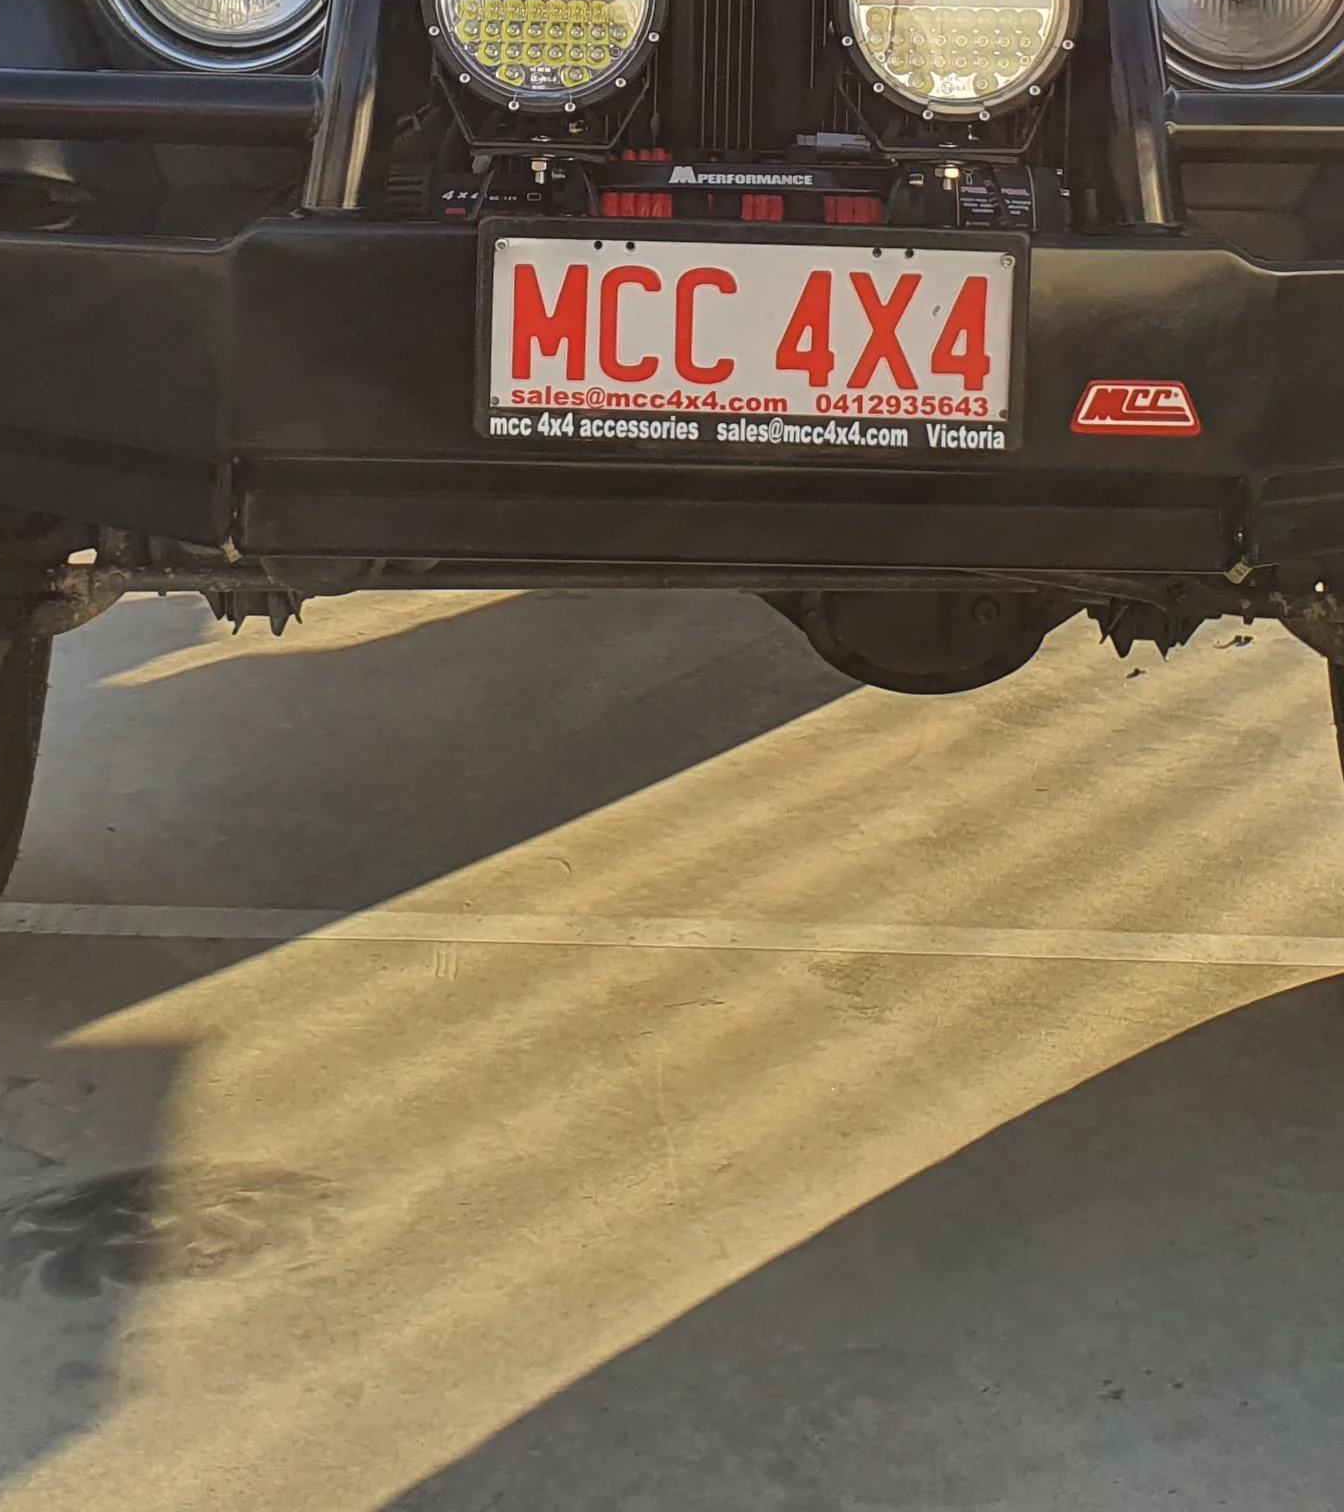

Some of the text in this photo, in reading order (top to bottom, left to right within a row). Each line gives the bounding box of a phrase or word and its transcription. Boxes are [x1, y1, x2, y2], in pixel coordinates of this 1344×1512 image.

[510, 263, 991, 391] MCC 4X4
[510, 385, 990, 417] sales@mcc4x4.com 0412935643
[489, 412, 1006, 450] mcc 4x4 accessories sales@mcc4x4.com Victoria
